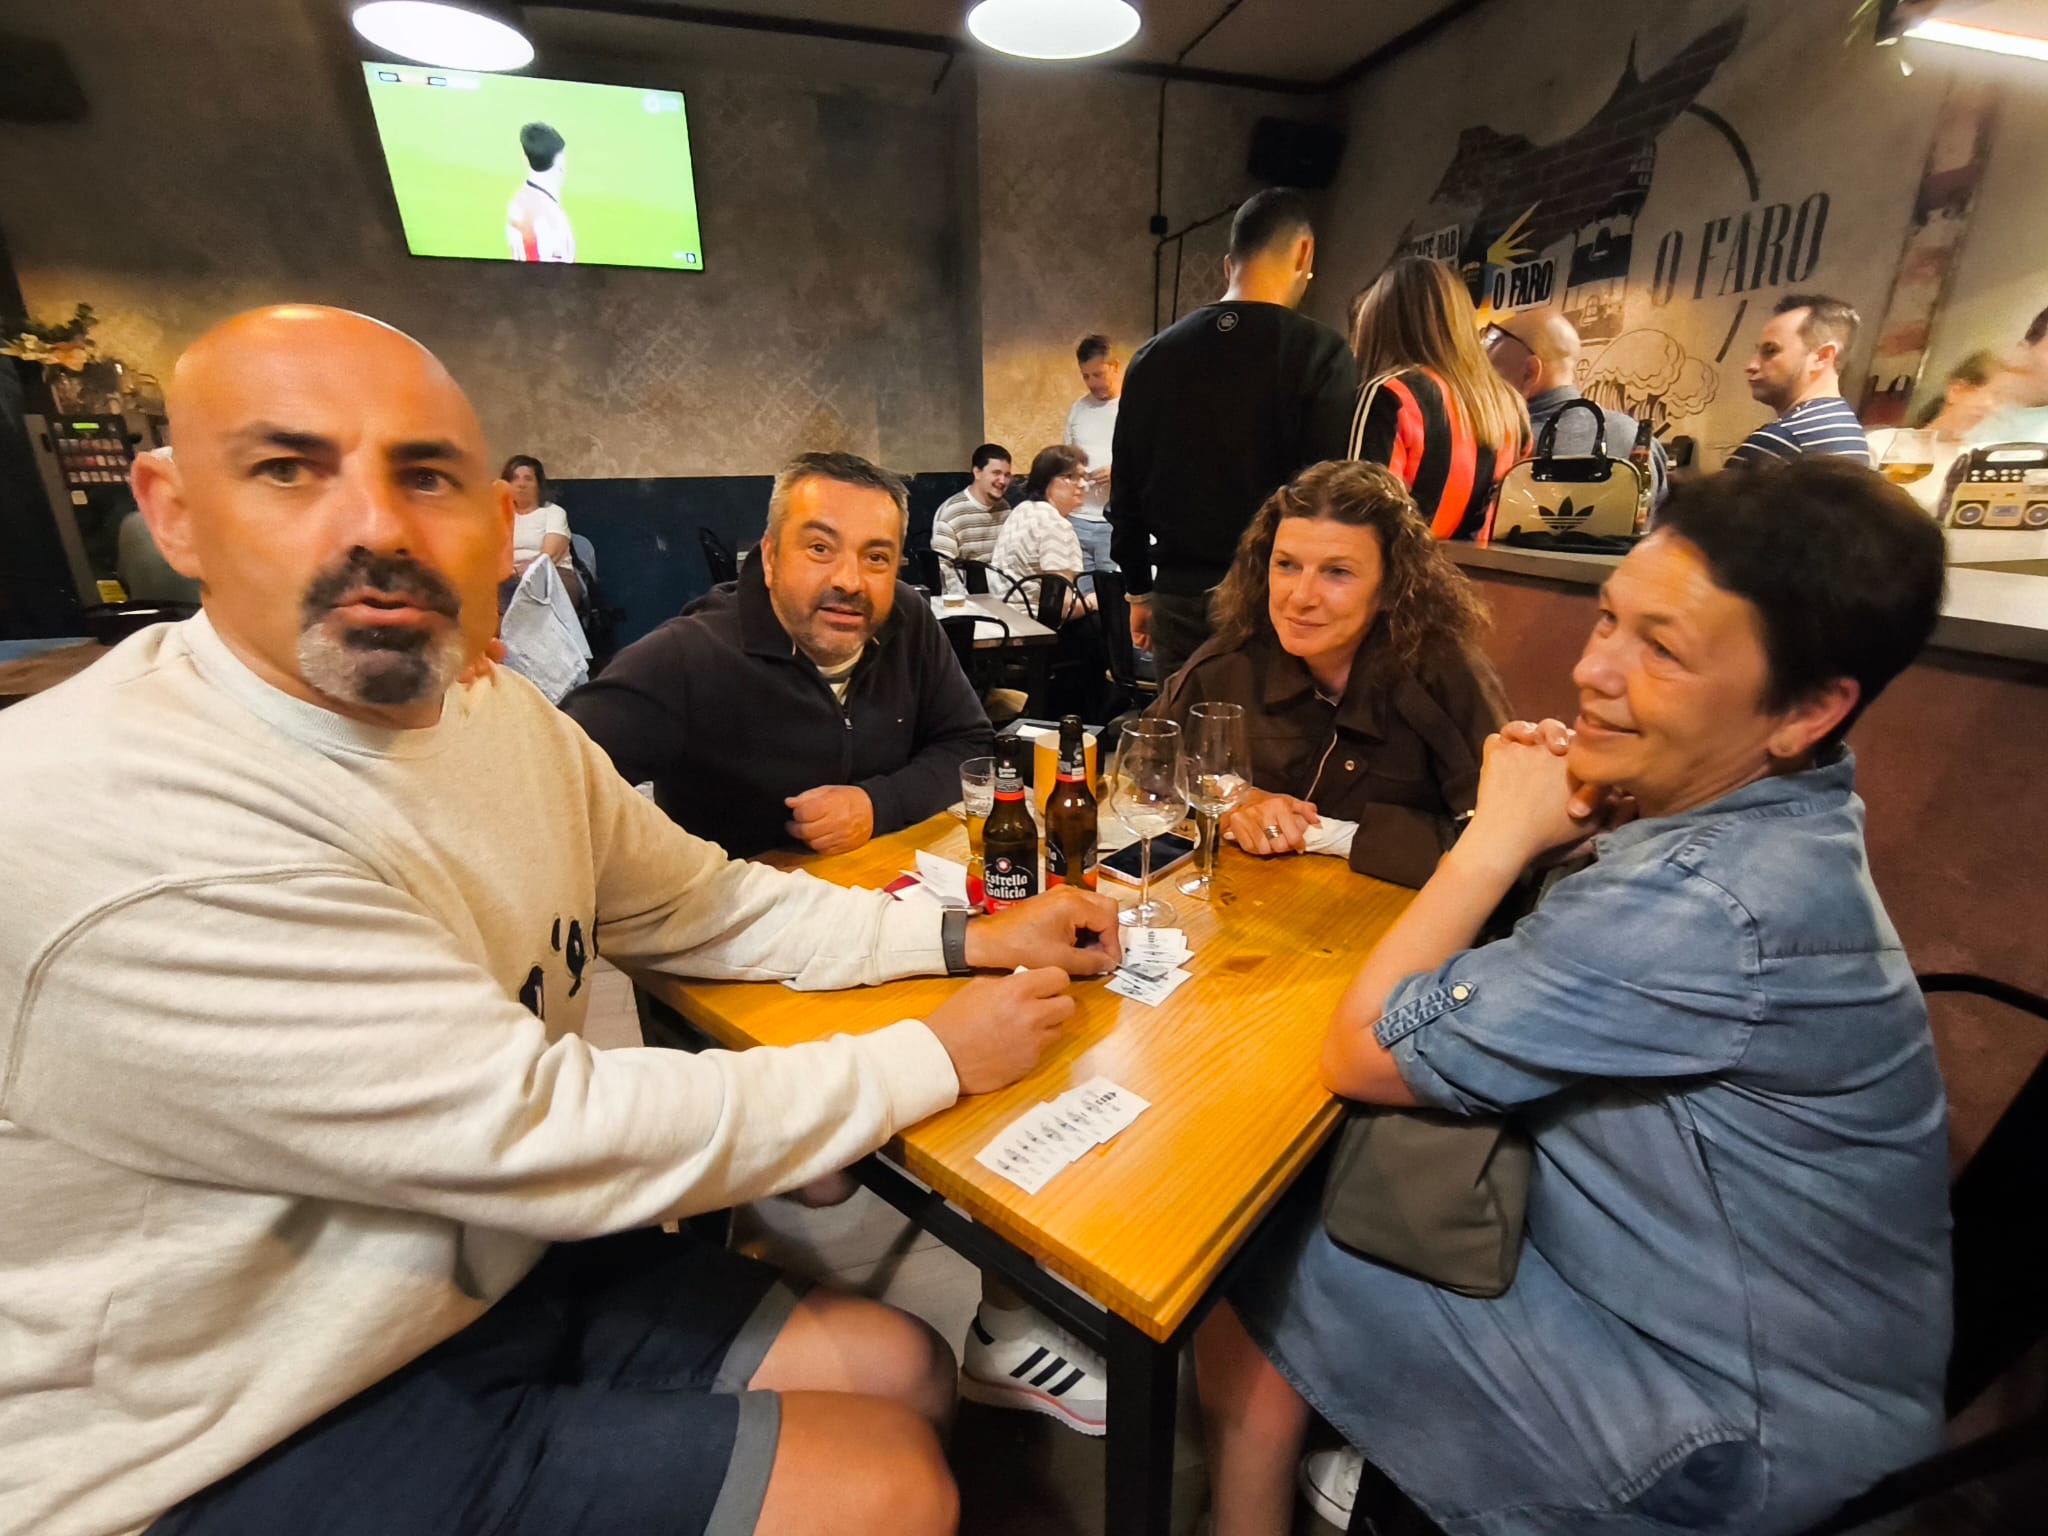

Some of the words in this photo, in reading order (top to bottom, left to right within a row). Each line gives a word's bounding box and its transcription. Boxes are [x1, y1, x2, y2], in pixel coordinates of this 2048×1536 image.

[1652, 229, 1684, 307] O
[1694, 192, 1831, 300] FARO
[1493, 272, 1505, 310] O
[1508, 260, 1554, 308] FARO
[985, 870, 1028, 887] Estrella
[986, 882, 1027, 899] Galicia
